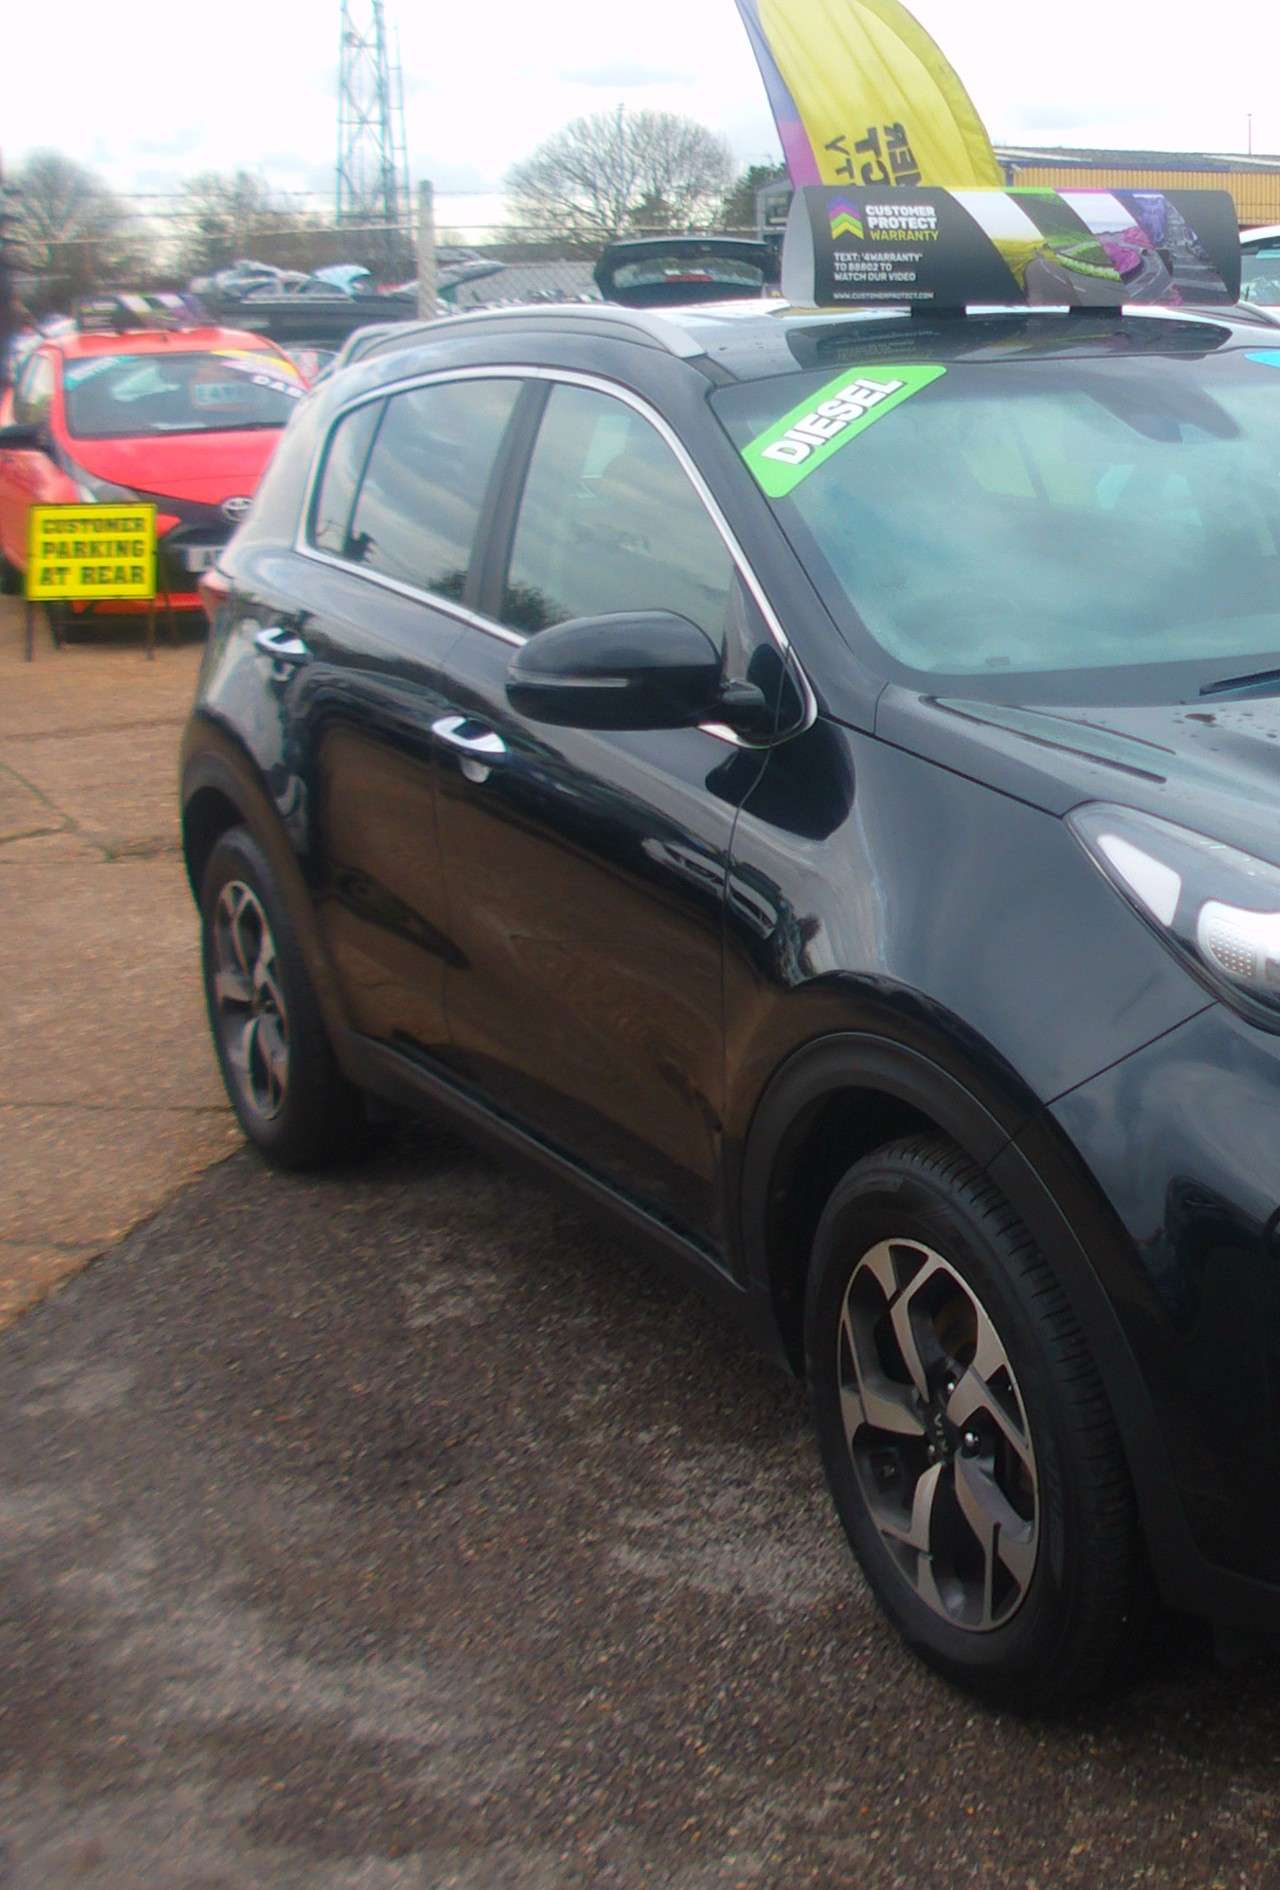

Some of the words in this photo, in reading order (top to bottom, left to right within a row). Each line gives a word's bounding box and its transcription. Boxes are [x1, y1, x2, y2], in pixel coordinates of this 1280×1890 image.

[865, 205, 936, 217] CUSTOMER
[868, 217, 938, 229] PROTECT
[870, 230, 940, 241] WARRANTY
[834, 262, 847, 271] TO
[880, 262, 893, 271] TO
[834, 272, 867, 281] WATCH
[868, 272, 888, 281] OUR
[889, 272, 917, 281] VIDEO
[761, 378, 907, 465] DIESEL
[41, 517, 146, 534] CUSTOMER
[41, 540, 145, 559] PARKING
[39, 566, 70, 585] AT
[80, 564, 145, 584] REAR
